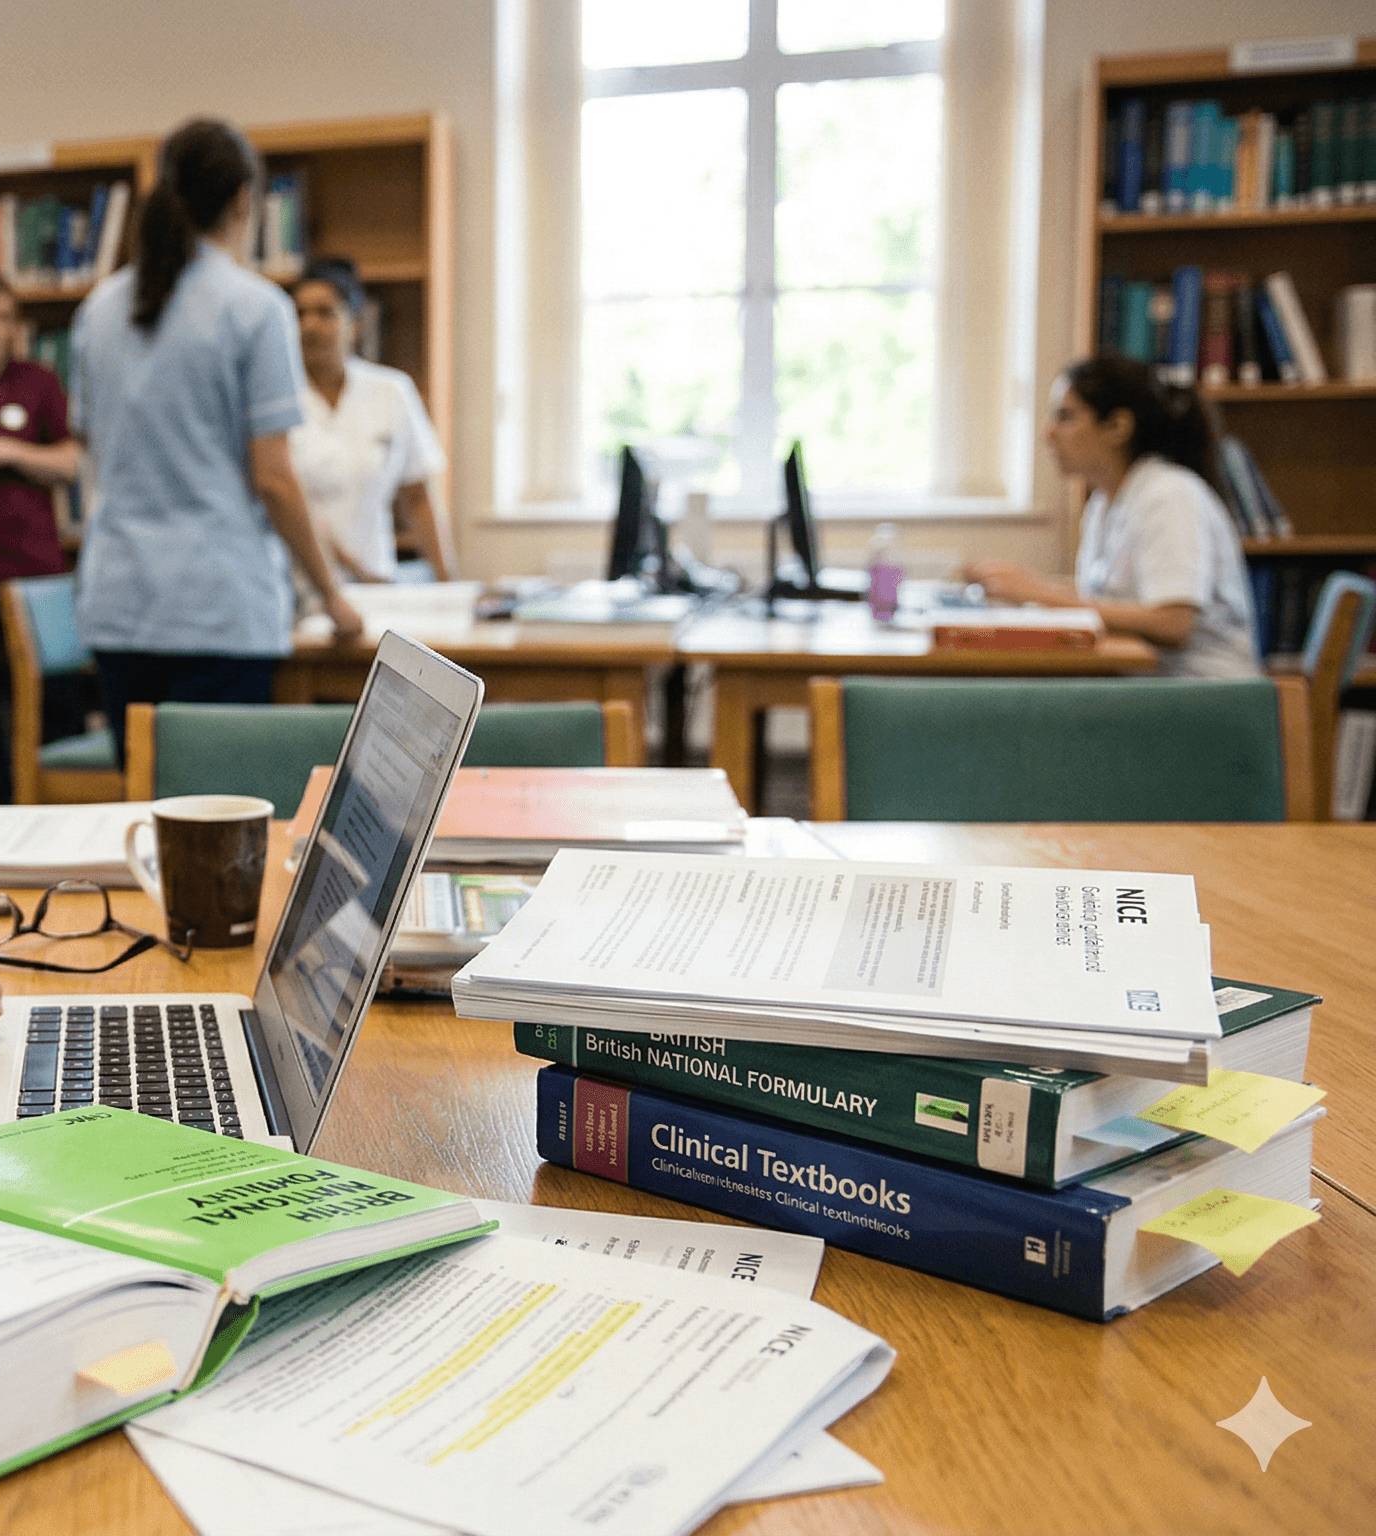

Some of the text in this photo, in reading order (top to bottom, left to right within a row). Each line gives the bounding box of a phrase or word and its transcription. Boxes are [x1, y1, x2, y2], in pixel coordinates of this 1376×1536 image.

[1115, 888, 1148, 925] NICE
[585, 1033, 642, 1062] British
[647, 1046, 743, 1088] NATIONAL
[747, 1070, 878, 1118] FORMULARY
[650, 1123, 748, 1173] Clinical
[757, 1148, 912, 1215] Textbooks
[775, 1191, 820, 1215] Clinical
[731, 1252, 763, 1281] NICE
[758, 1323, 813, 1356] NICE
